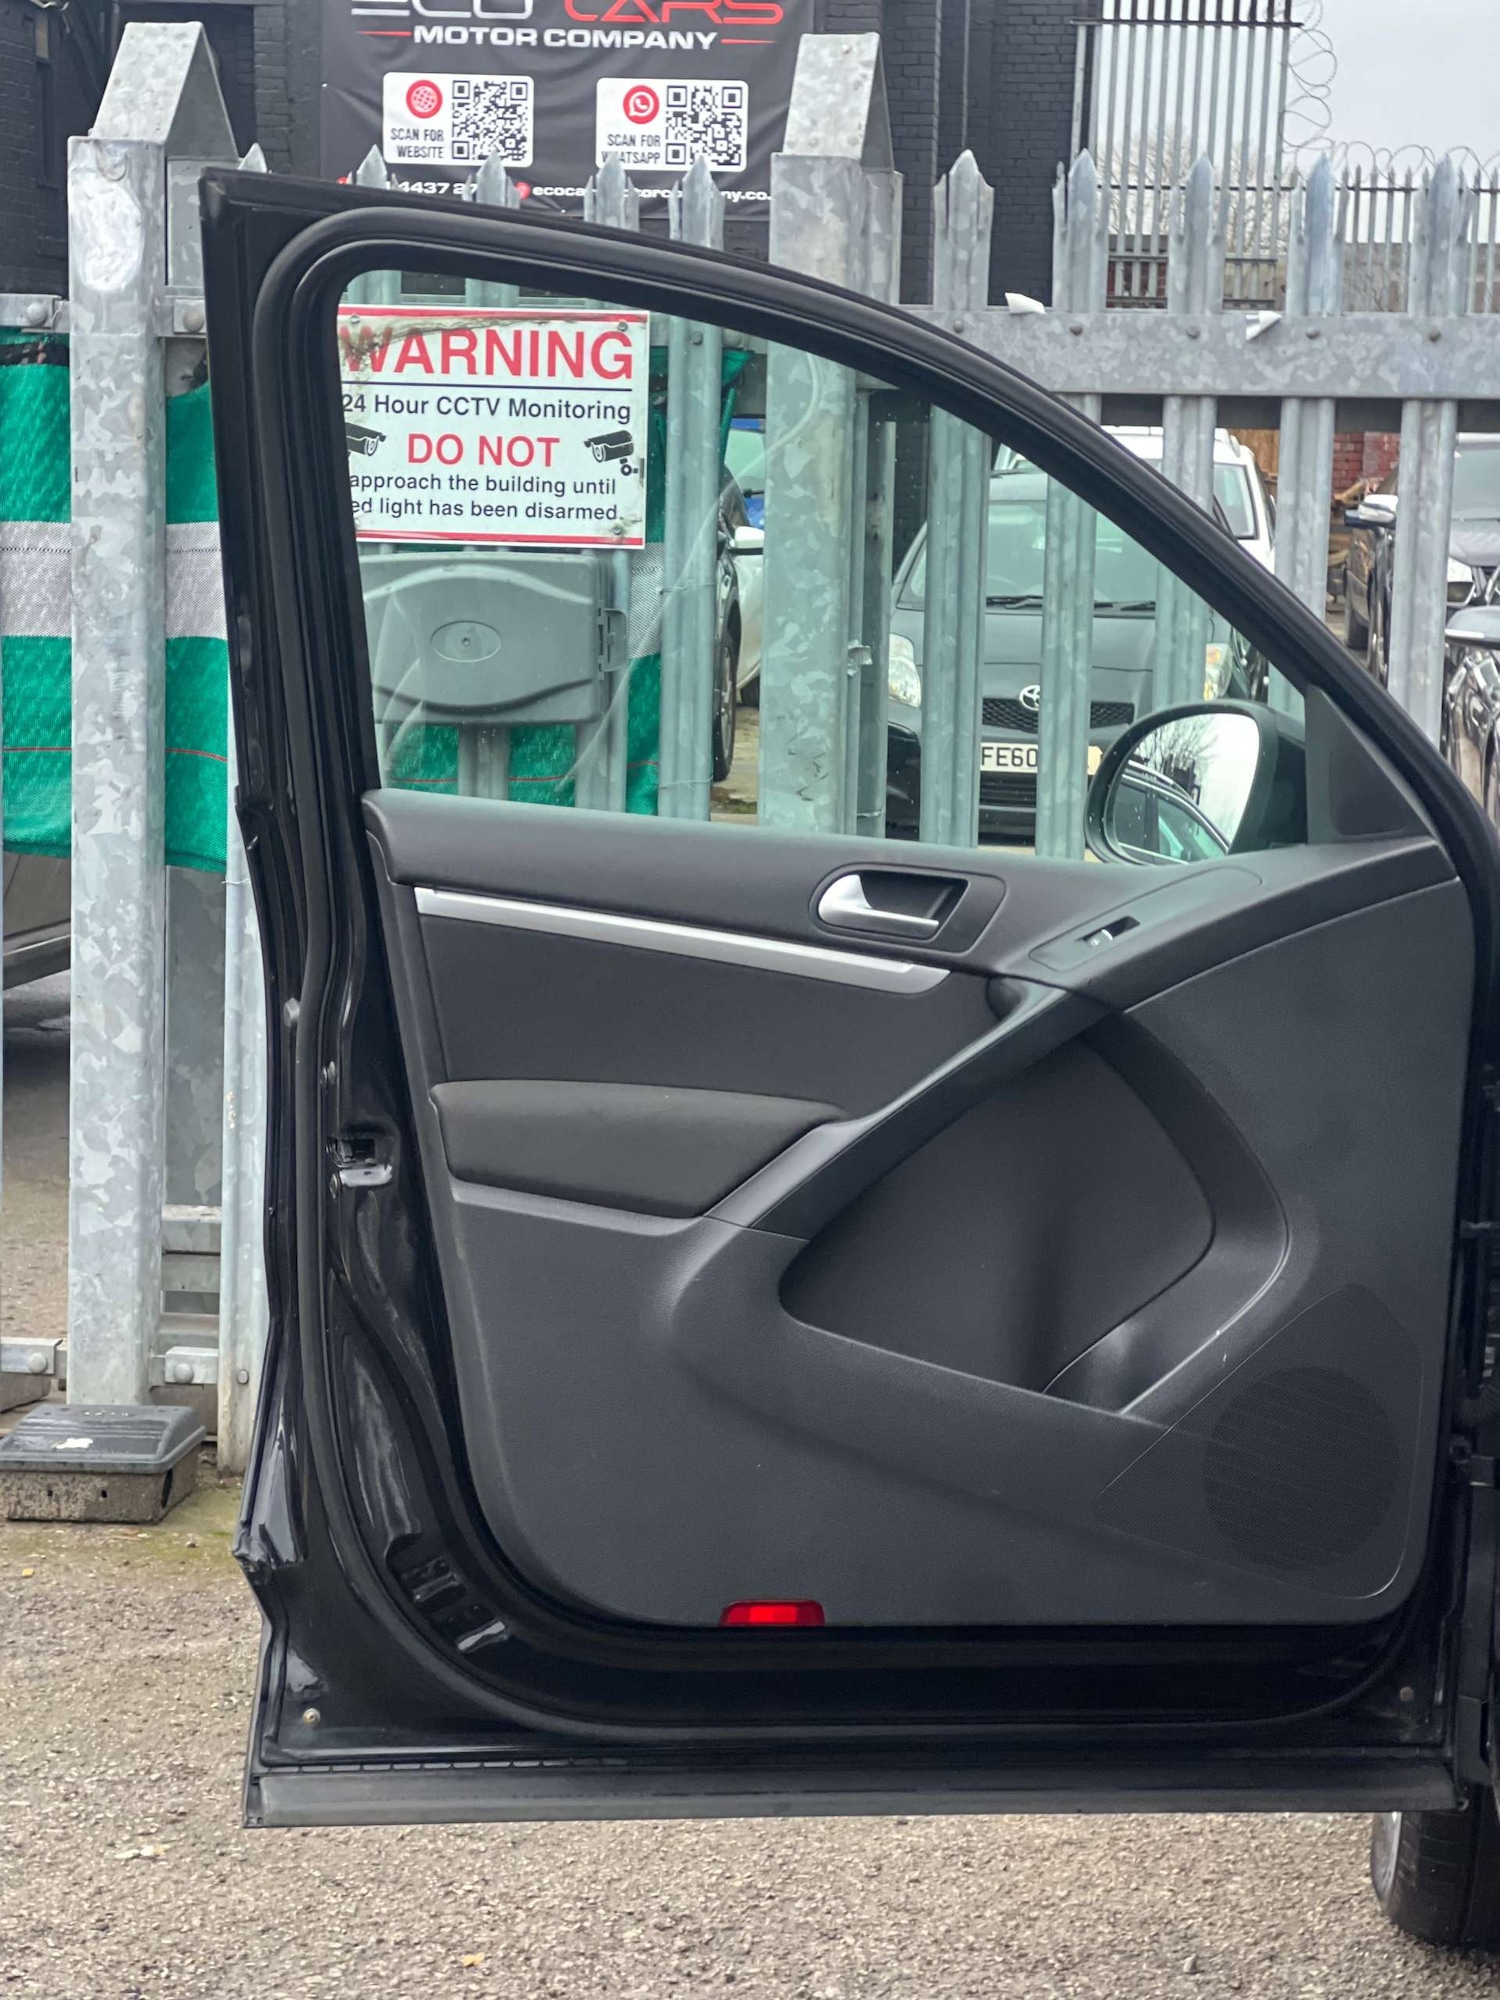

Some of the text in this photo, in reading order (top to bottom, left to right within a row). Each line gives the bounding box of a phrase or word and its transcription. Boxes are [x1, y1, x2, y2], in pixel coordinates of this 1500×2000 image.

[413, 24, 718, 50] MOTOR COMPANY
[391, 128, 444, 141] SCAN FOR
[607, 133, 661, 147] SCAN FOR
[397, 146, 444, 158] WEBSITE
[340, 325, 633, 379] WARNING
[342, 394, 632, 424] 24 Hour CCTV Monitoring
[407, 433, 560, 467] DO NOT
[350, 473, 616, 497] approach the building until
[380, 498, 423, 518] light
[430, 499, 464, 516] has
[471, 500, 518, 517] been
